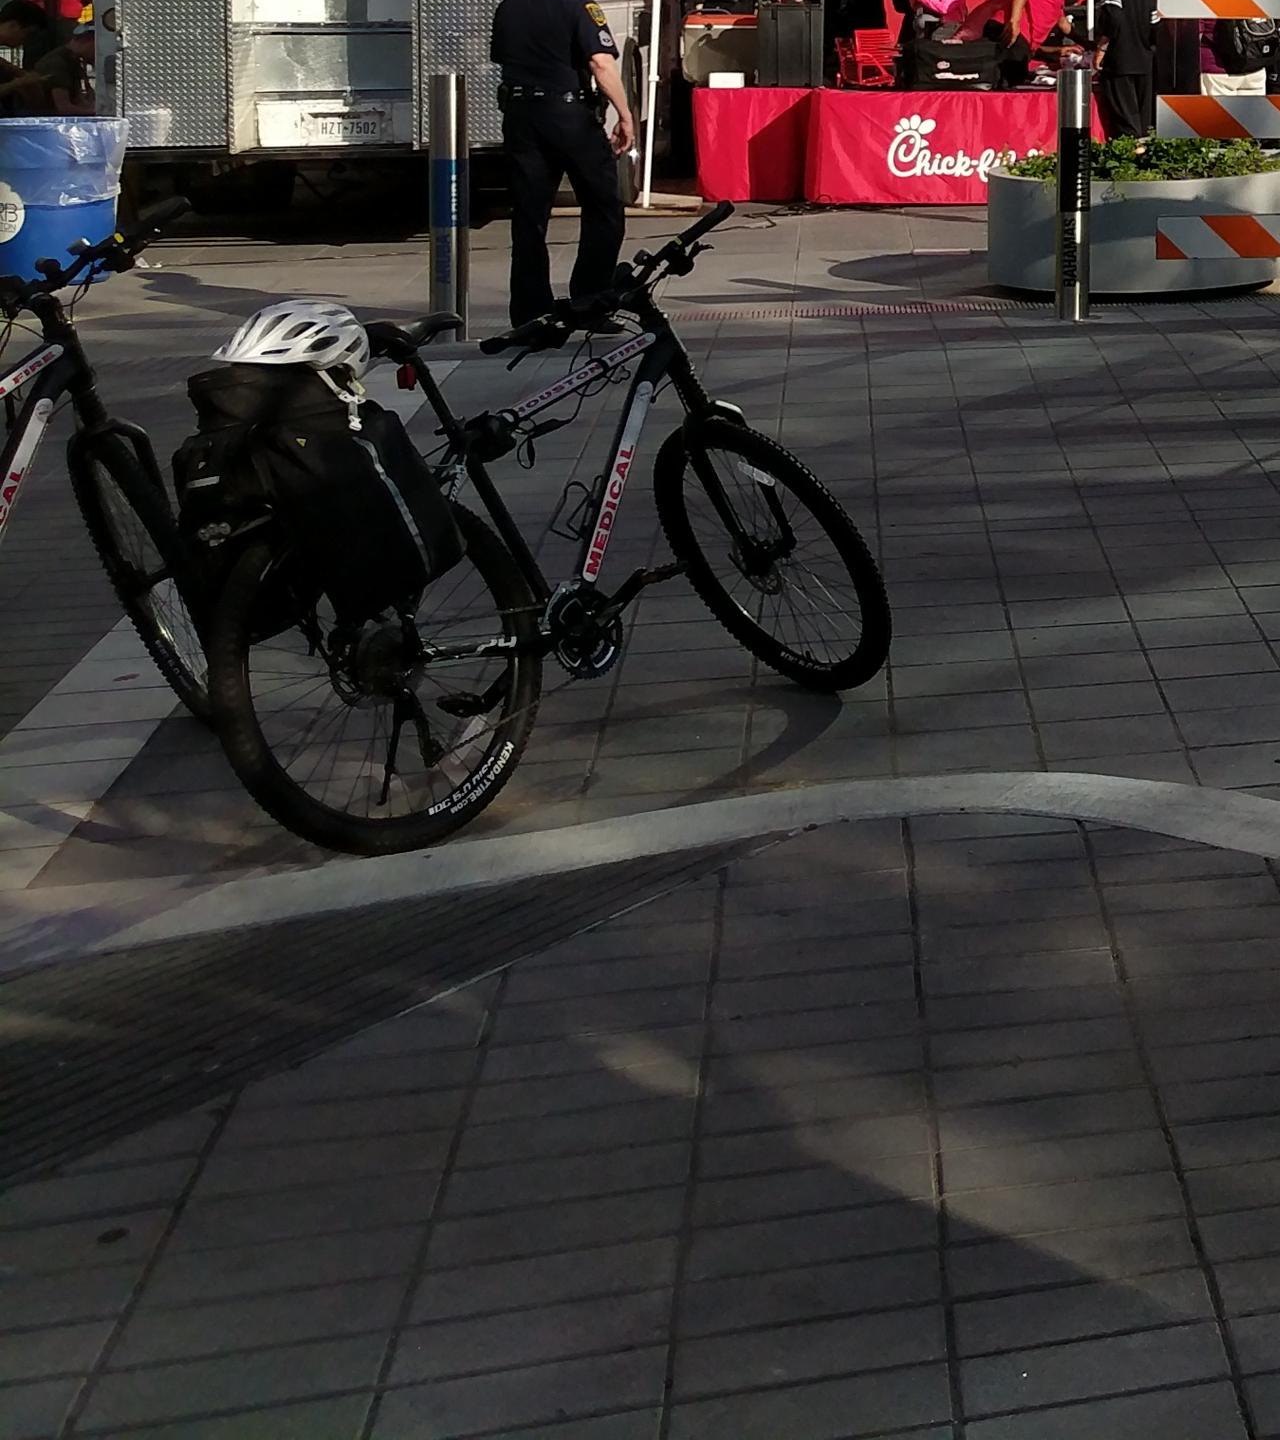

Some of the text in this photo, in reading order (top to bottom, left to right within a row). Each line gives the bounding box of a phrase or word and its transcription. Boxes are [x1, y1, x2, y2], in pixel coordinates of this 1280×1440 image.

[1062, 217, 1077, 288] BAHAMAS
[12, 351, 56, 385] FIRE
[516, 335, 649, 415] HOUSTON FIRE
[585, 444, 635, 576] MEDICAL
